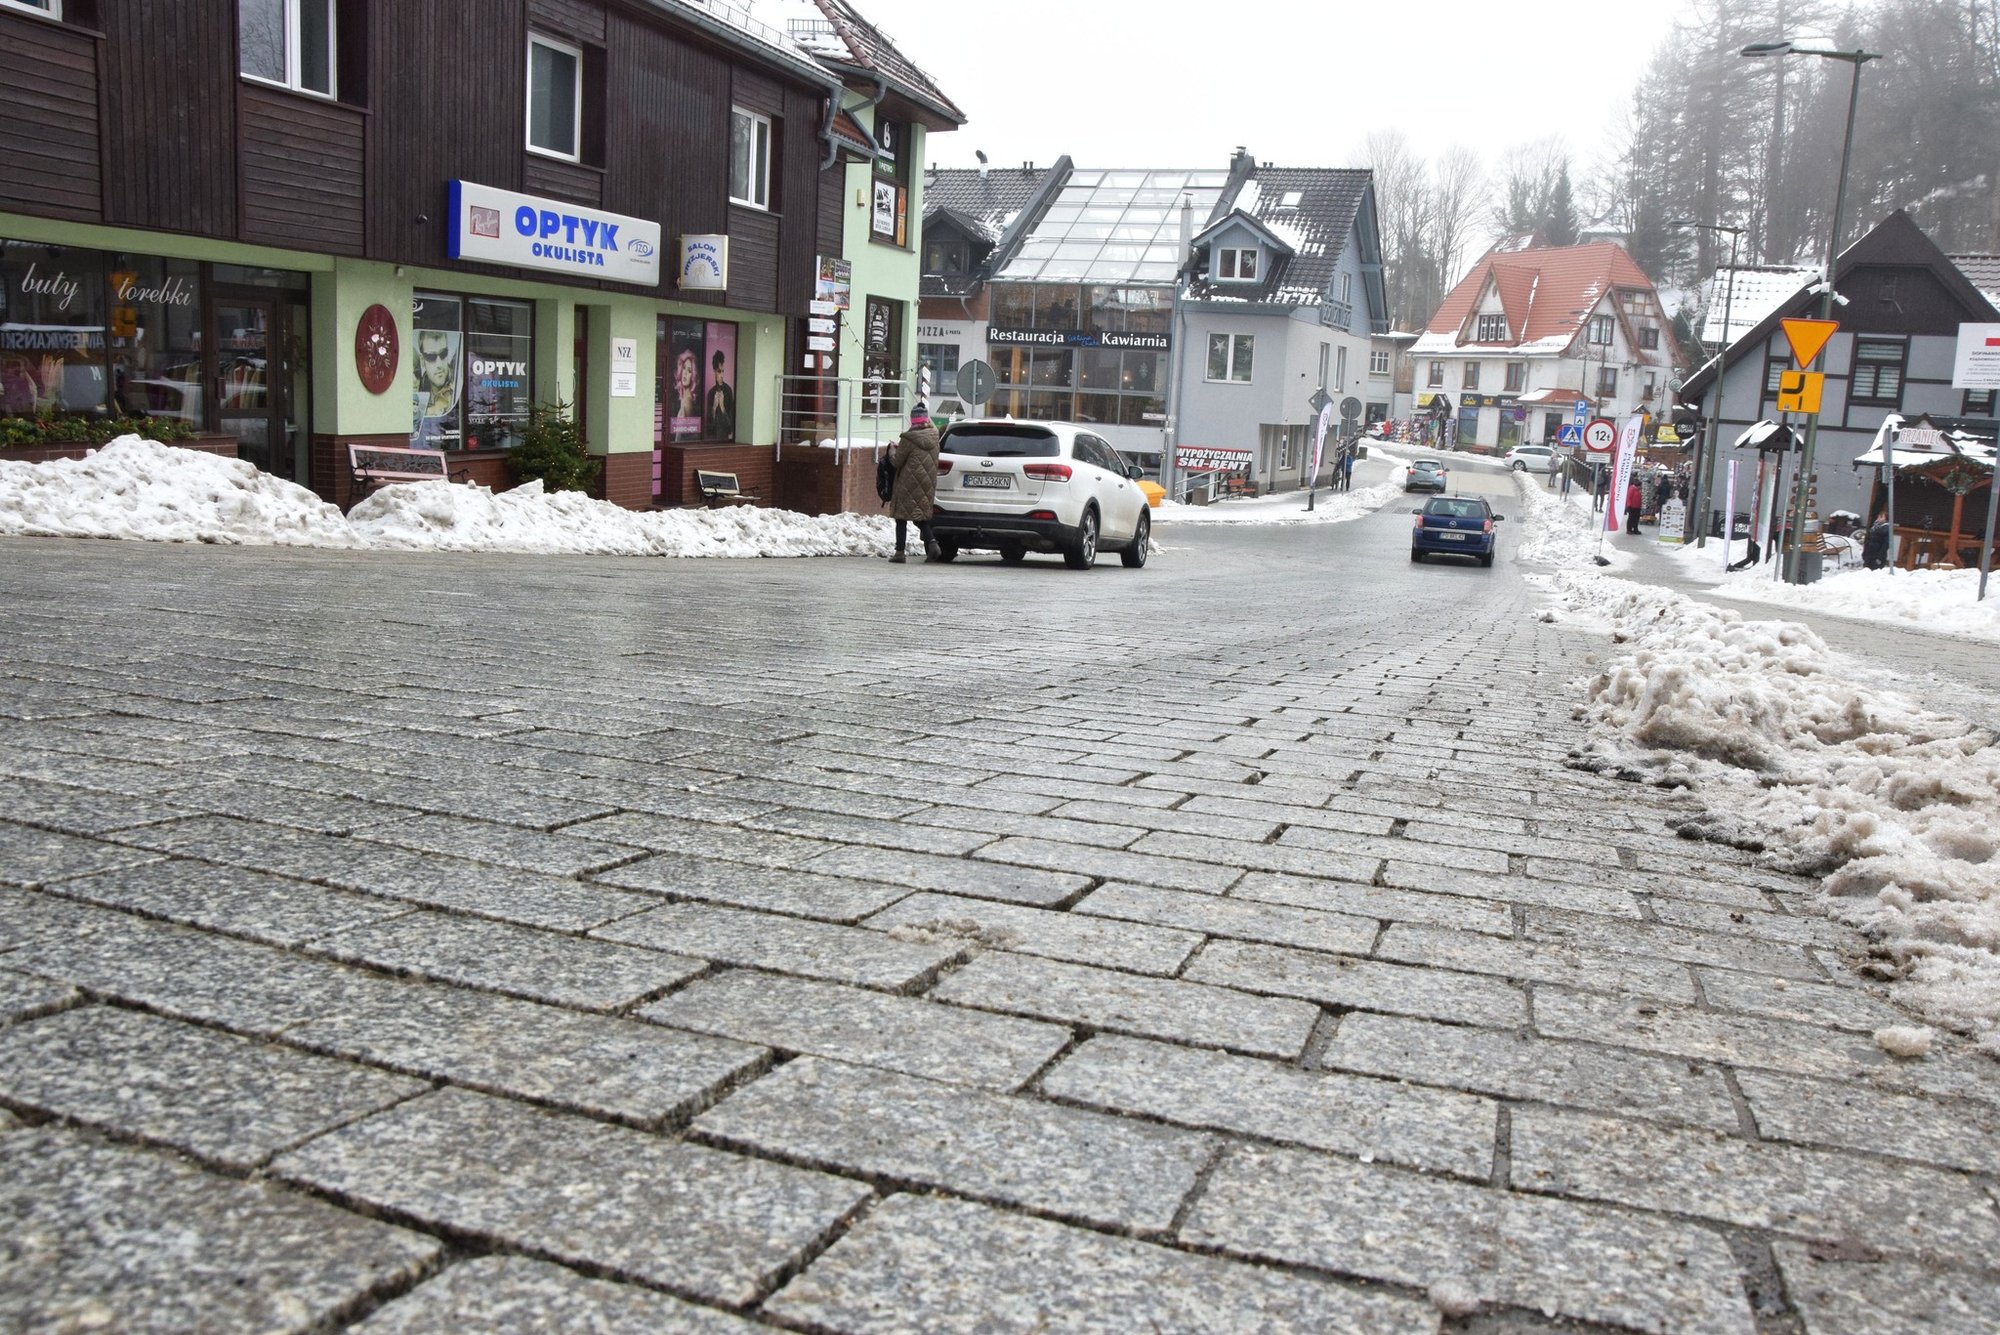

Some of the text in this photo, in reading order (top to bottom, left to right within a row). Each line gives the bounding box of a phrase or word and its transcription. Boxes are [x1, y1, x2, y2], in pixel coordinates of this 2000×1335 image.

[515, 205, 620, 251] OPTYK
[532, 242, 605, 266] OKULISTA
[687, 243, 716, 253] SALON
[684, 253, 720, 277] FRYZJERSKI
[21, 262, 80, 311] buty
[117, 276, 194, 306] torebki
[917, 326, 944, 337] PIZZA
[990, 328, 1065, 345] Restauracja
[1102, 332, 1168, 348] Kawiarnia
[617, 346, 632, 358] NFZ
[472, 360, 526, 376] OPTYK
[481, 379, 519, 388] OKULISTA
[1577, 401, 1586, 411] P
[1899, 427, 1943, 445] GRZANIEC
[1176, 447, 1253, 462] WYPOŻYCZALNIA
[1178, 457, 1250, 471] SKI-RENT
[967, 475, 983, 485] PGN
